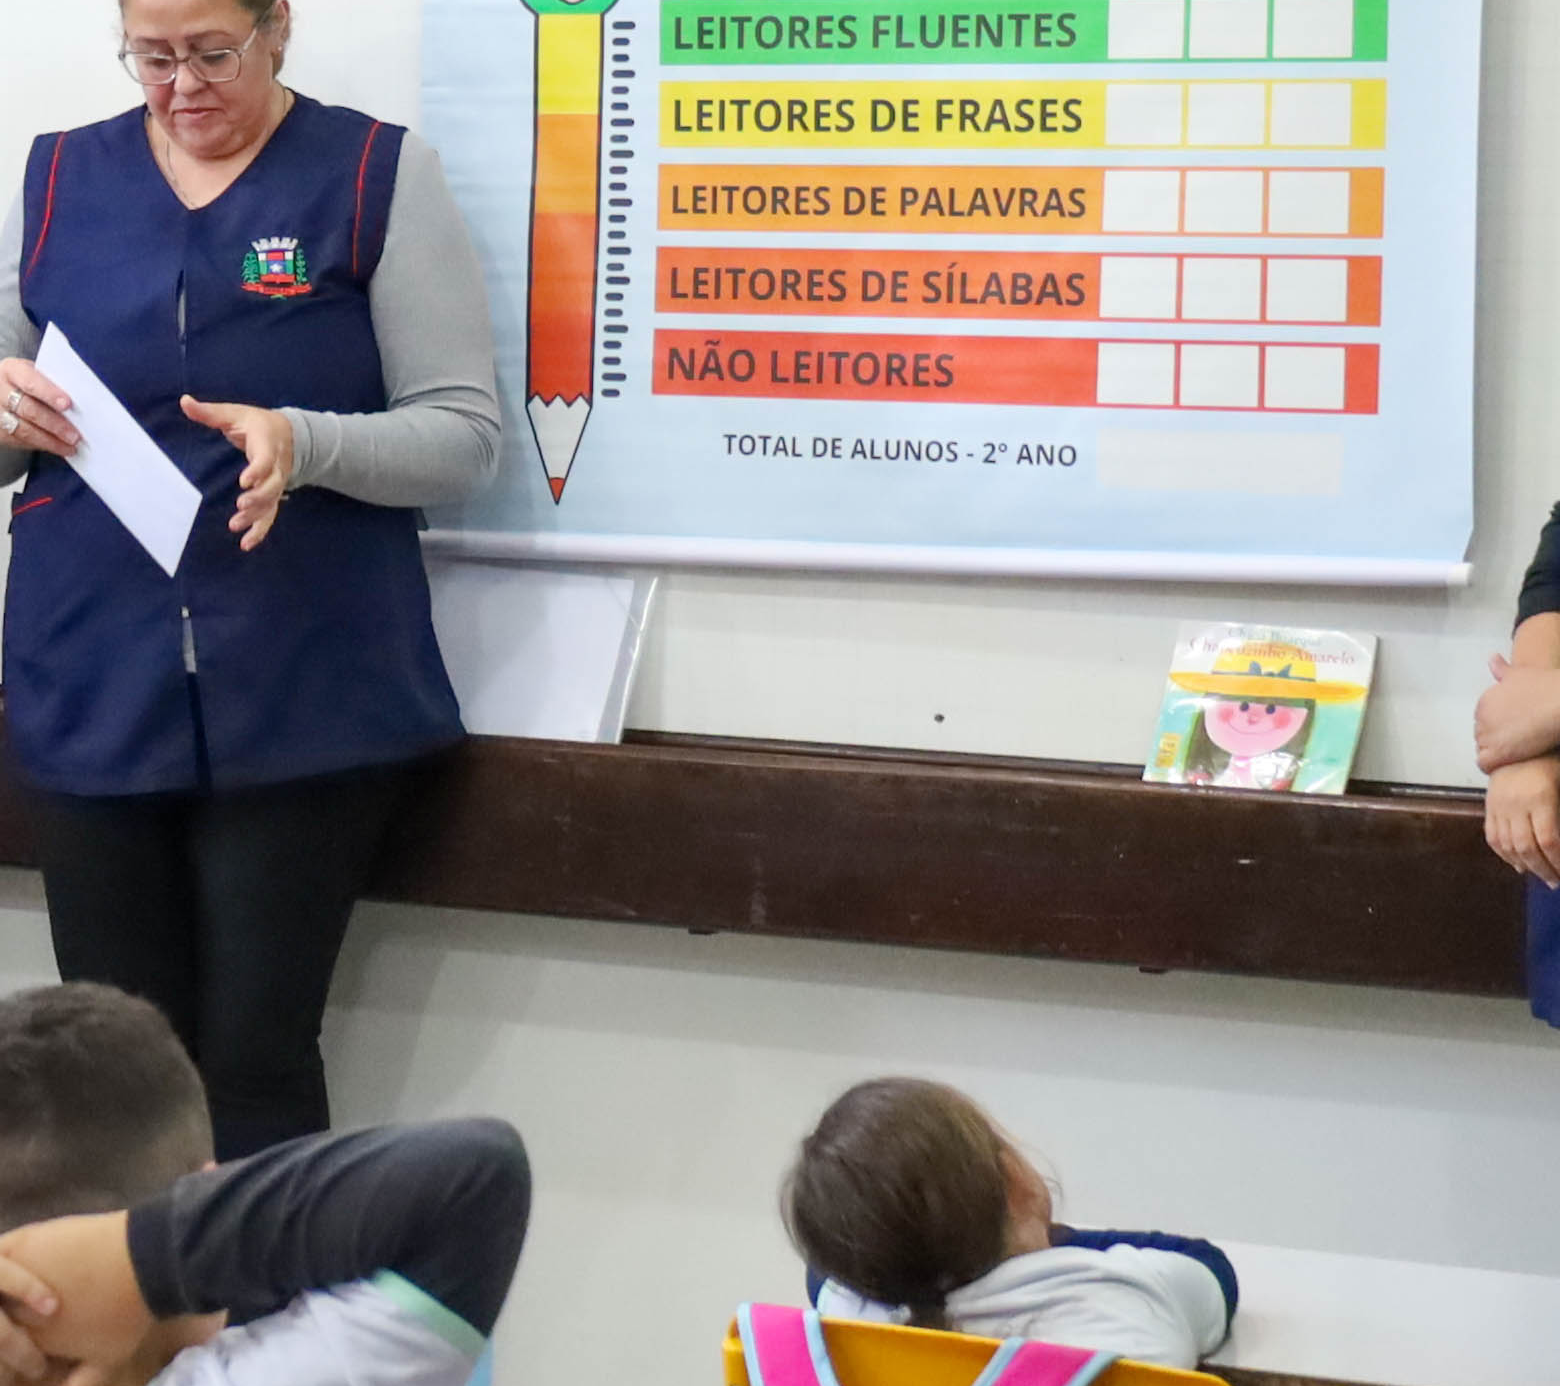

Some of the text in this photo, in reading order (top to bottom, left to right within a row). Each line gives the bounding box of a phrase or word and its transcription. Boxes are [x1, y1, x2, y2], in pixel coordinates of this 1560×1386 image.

[674, 13, 1077, 50] LEITORES FLUENTES
[673, 98, 1082, 132] LEITORES DE FRASES
[672, 185, 1086, 218] LEITORES DE PALAVRAS
[670, 262, 1086, 307] LEITORES DE SÍLABAS
[668, 340, 954, 388] NÃO LEITORES
[723, 434, 802, 458] TOTAL
[812, 437, 842, 459] DE
[851, 438, 959, 463] ALUNOS
[1016, 444, 1077, 466] ANO
